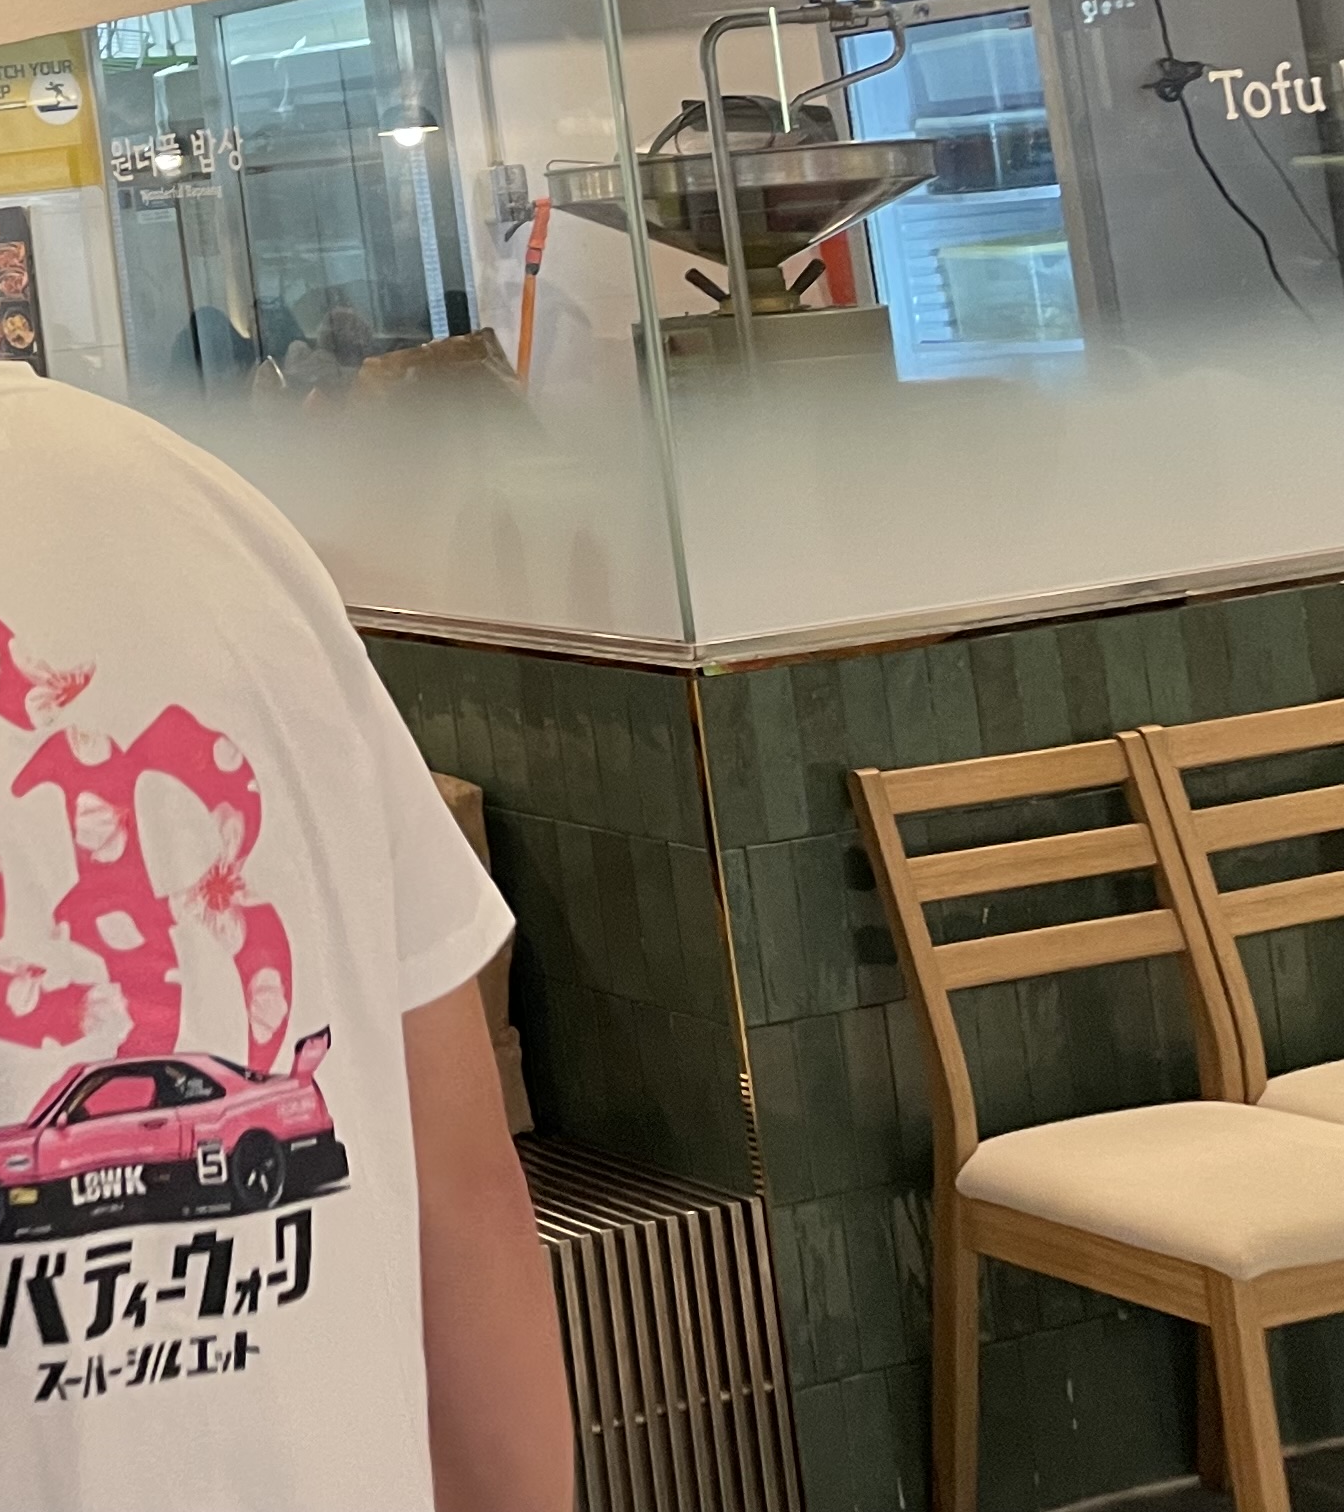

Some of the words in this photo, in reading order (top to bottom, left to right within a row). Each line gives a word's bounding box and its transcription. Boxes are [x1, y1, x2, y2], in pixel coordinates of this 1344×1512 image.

[28, 59, 73, 76] YOUR
[1207, 61, 1327, 121] Tofu
[190, 125, 244, 174] 밥상
[70, 1163, 148, 1207] LBWK
